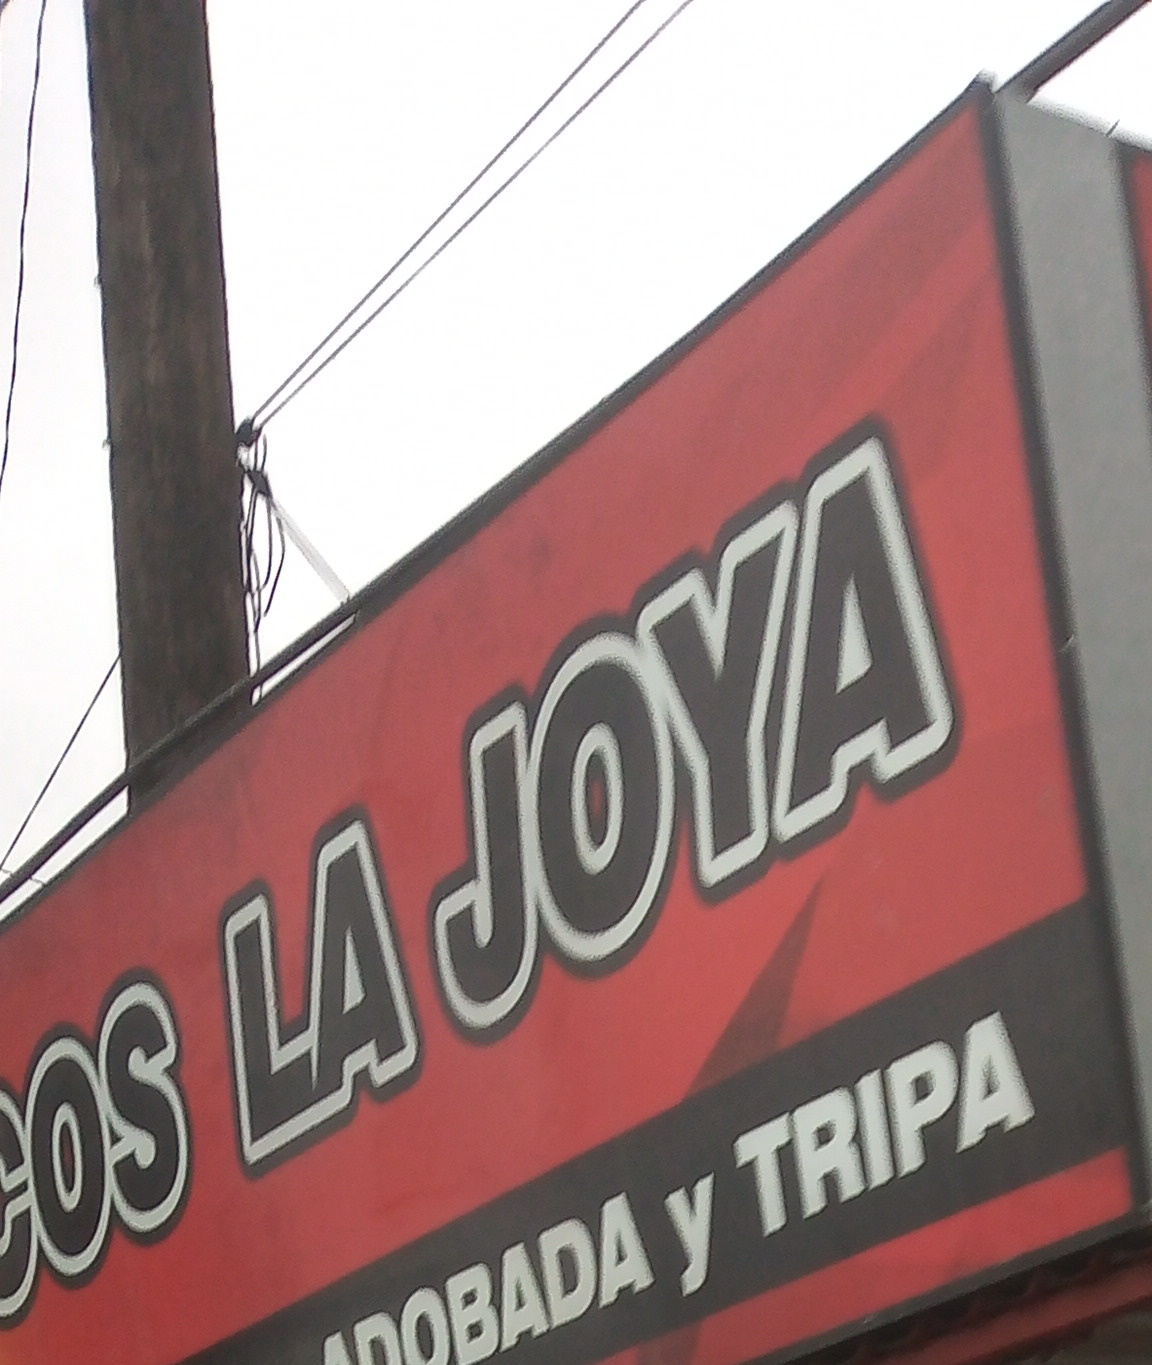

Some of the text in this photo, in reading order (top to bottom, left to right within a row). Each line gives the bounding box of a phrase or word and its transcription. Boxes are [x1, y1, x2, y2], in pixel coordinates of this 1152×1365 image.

[223, 822, 418, 1163] LA
[434, 436, 953, 1028] JOYA
[663, 1172, 717, 1296] y
[734, 1013, 1035, 1236] TRIPA
